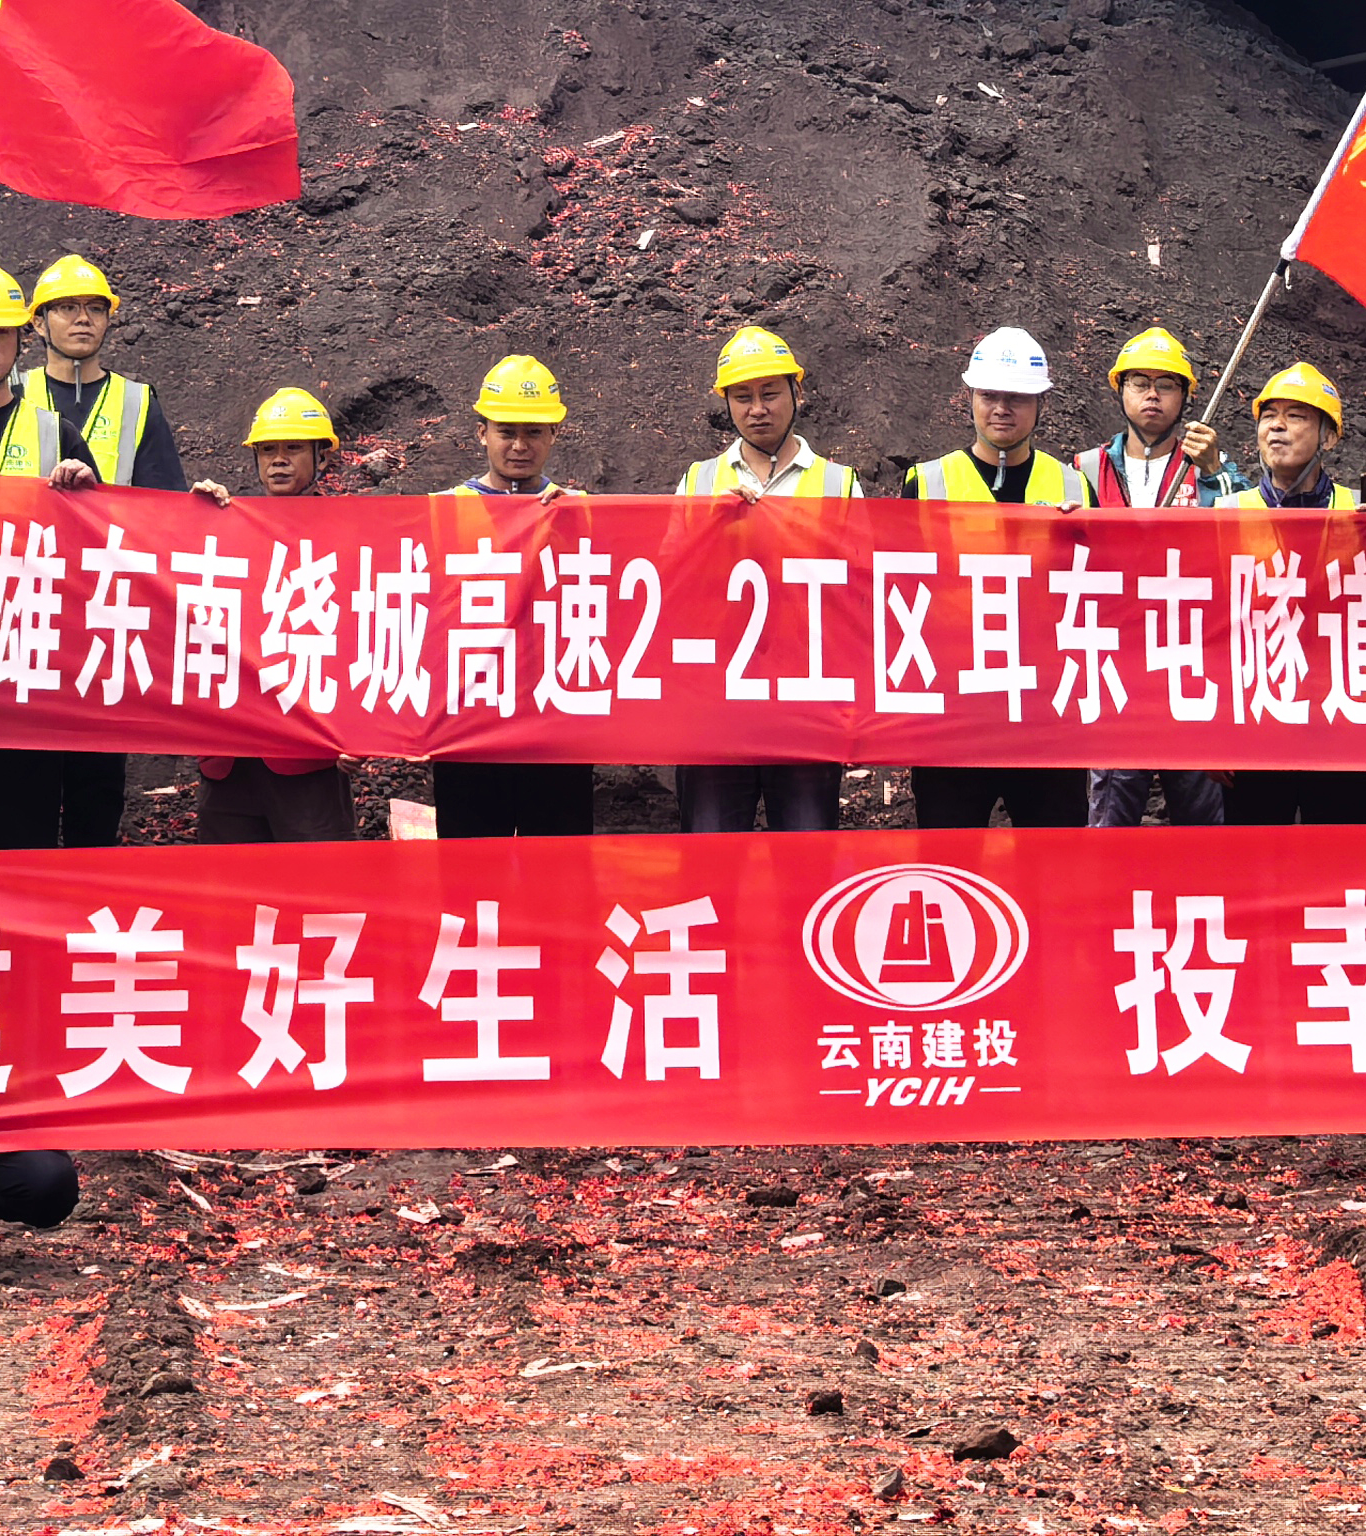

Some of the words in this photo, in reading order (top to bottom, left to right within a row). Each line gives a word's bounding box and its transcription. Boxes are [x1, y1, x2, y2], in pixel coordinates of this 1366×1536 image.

[816, 1018, 1019, 1070] 云南建投
[864, 1075, 976, 1107] YCIH
